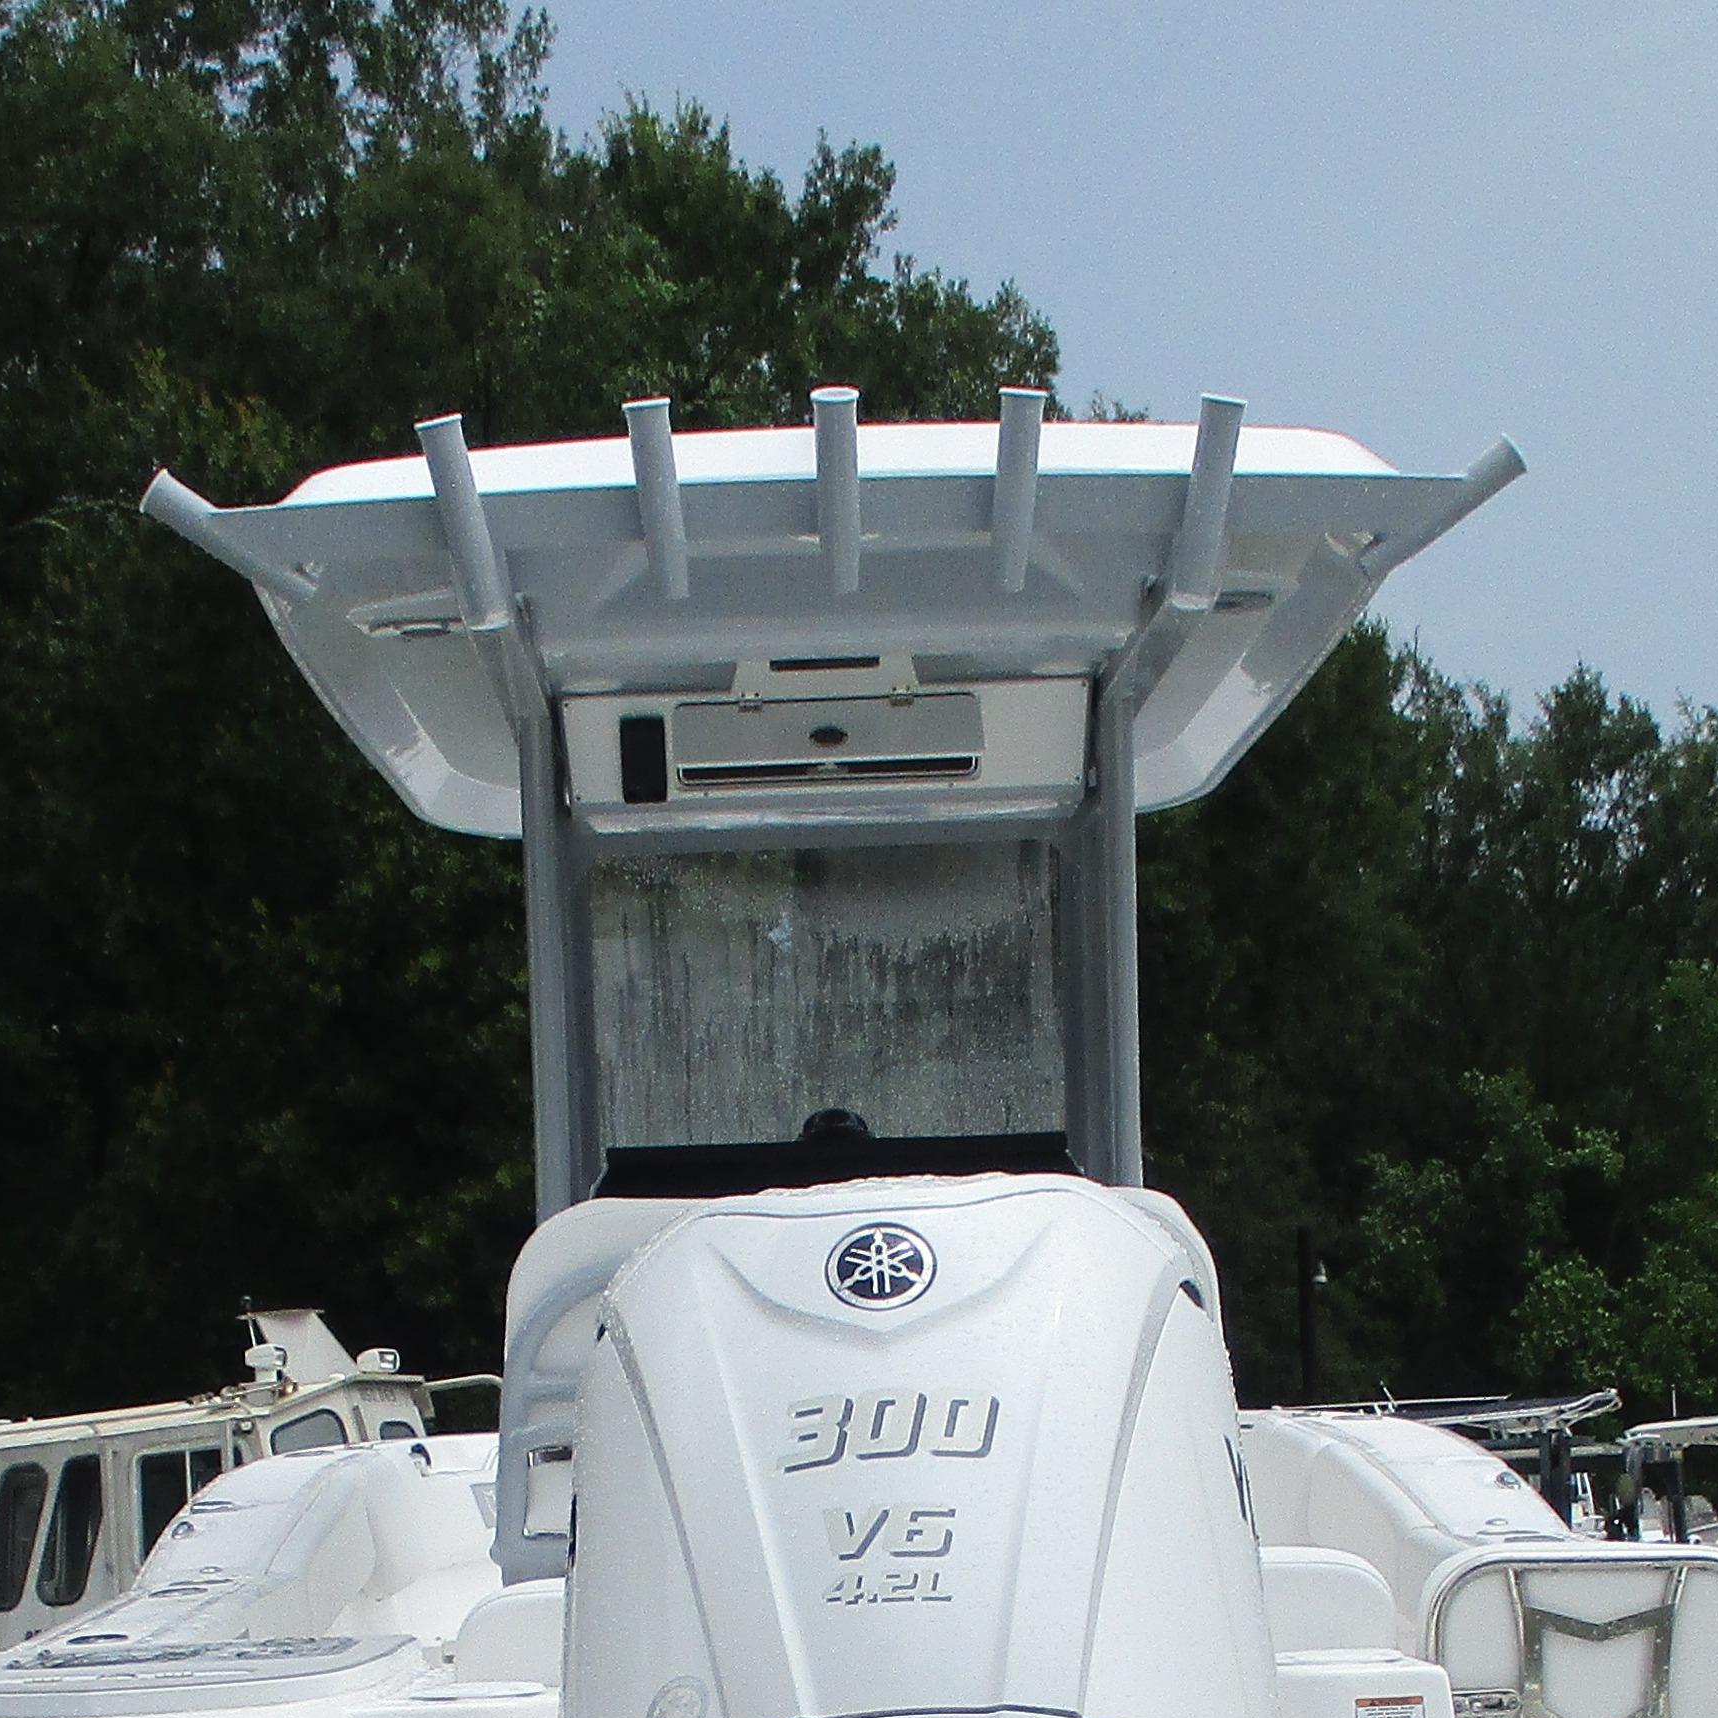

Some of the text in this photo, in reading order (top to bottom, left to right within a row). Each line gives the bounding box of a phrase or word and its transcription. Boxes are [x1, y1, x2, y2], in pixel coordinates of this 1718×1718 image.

[777, 1389, 1000, 1473] 300
[824, 1503, 957, 1560] V6
[823, 1570, 952, 1606] 4.2L
